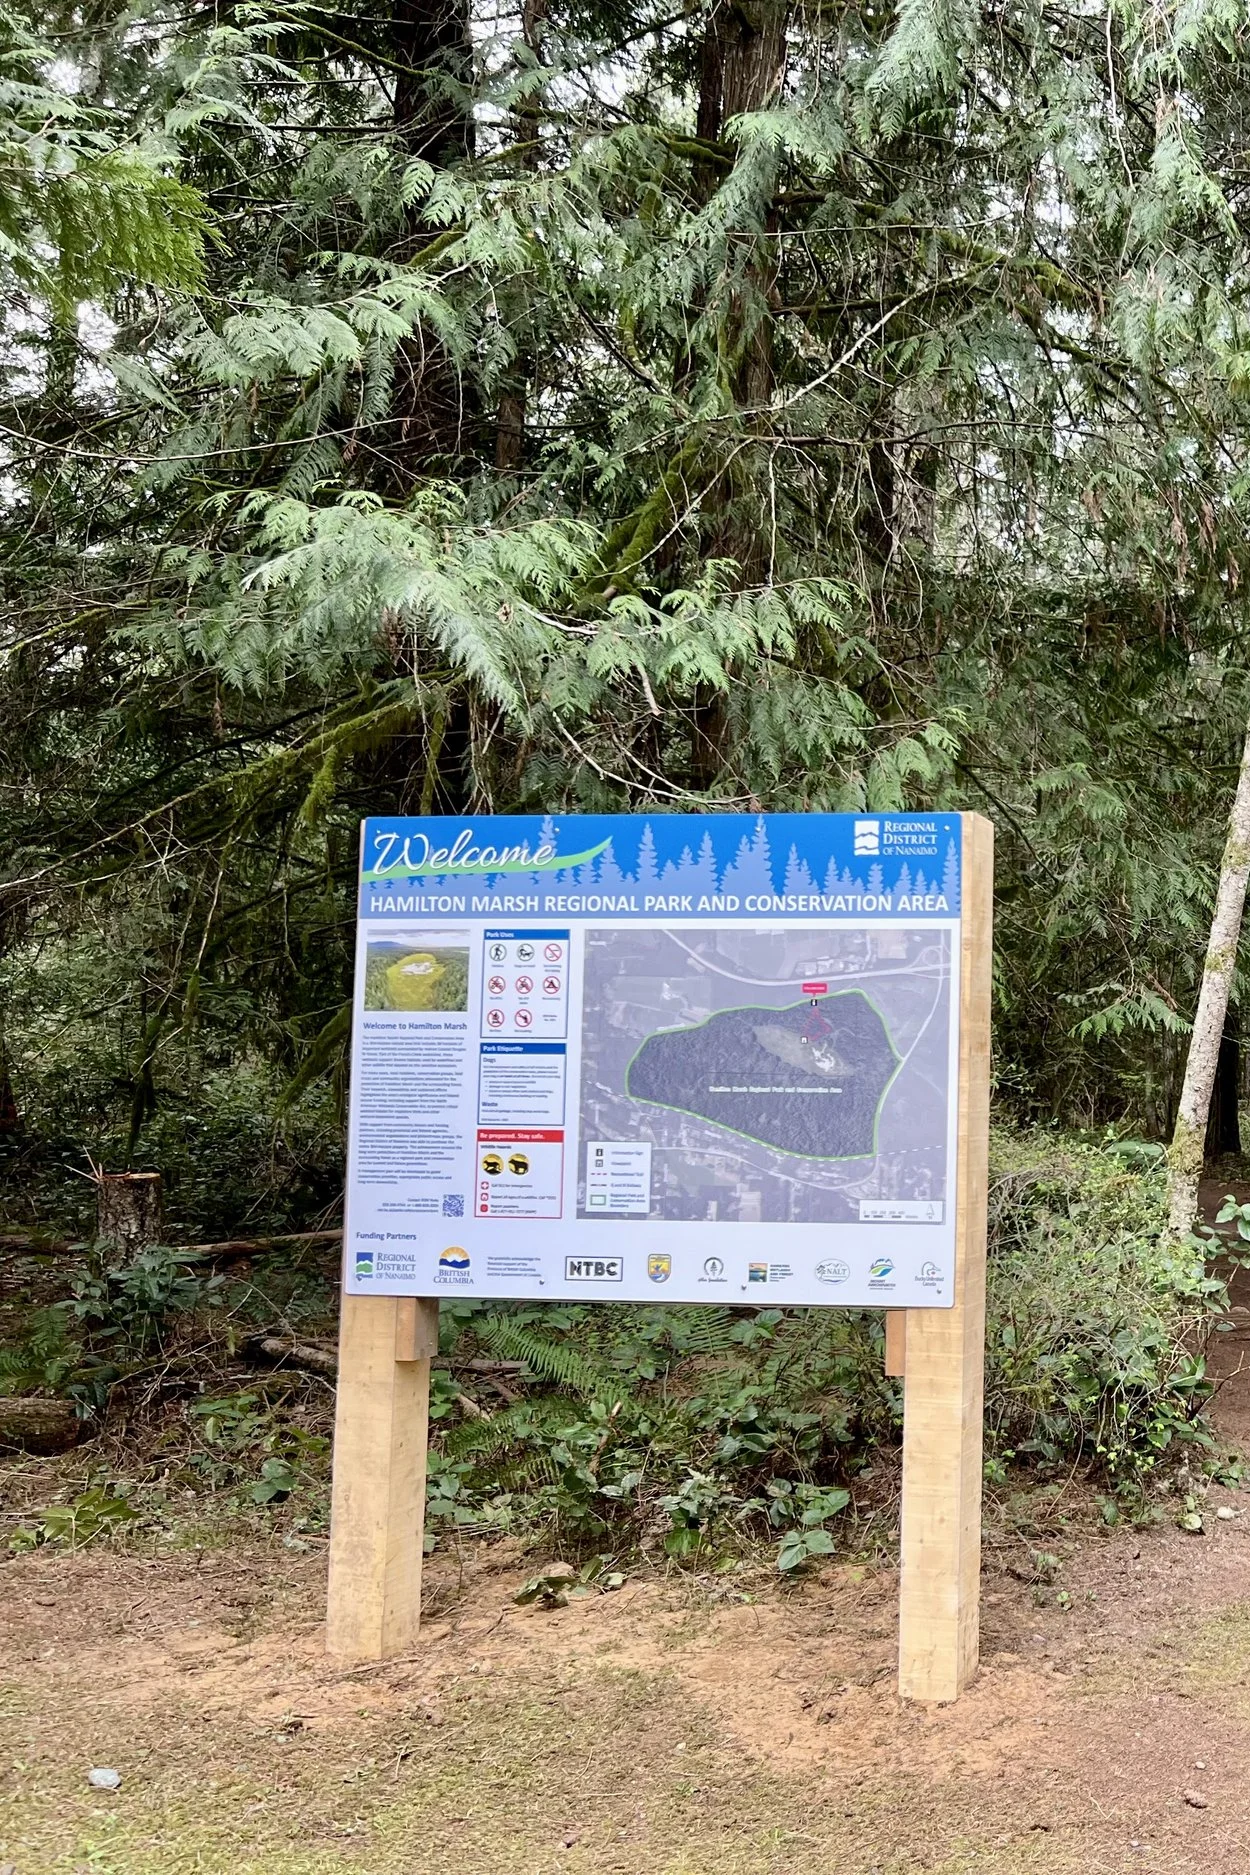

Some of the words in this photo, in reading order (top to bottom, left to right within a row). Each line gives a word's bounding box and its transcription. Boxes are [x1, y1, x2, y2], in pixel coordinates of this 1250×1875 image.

[884, 820, 938, 833] REGIONAL
[883, 833, 937, 845] DISTRICT
[373, 829, 556, 876] Welcome
[883, 847, 893, 856] OF
[894, 846, 938, 856] NANAIMO
[370, 896, 465, 912] HAMILTON
[471, 895, 539, 912] MARSH
[544, 895, 639, 912] REGIONAL
[644, 895, 692, 912] PARK
[697, 895, 740, 912] AND
[745, 895, 894, 912] CONSERVATION
[896, 895, 949, 912] AREA
[363, 1022, 397, 1030] Welcome
[408, 1022, 442, 1030] Hamilton
[444, 1022, 468, 1030] Marsh
[356, 1232, 385, 1241] Funding
[386, 1232, 417, 1241] Partners
[377, 1252, 416, 1262] REGIONAL
[376, 1262, 416, 1271] DISTRICT
[569, 1261, 618, 1277] NTBC
[826, 1267, 847, 1276] NALT
[438, 1269, 470, 1277] BRITISH
[433, 1276, 474, 1285] COLUMBIA
